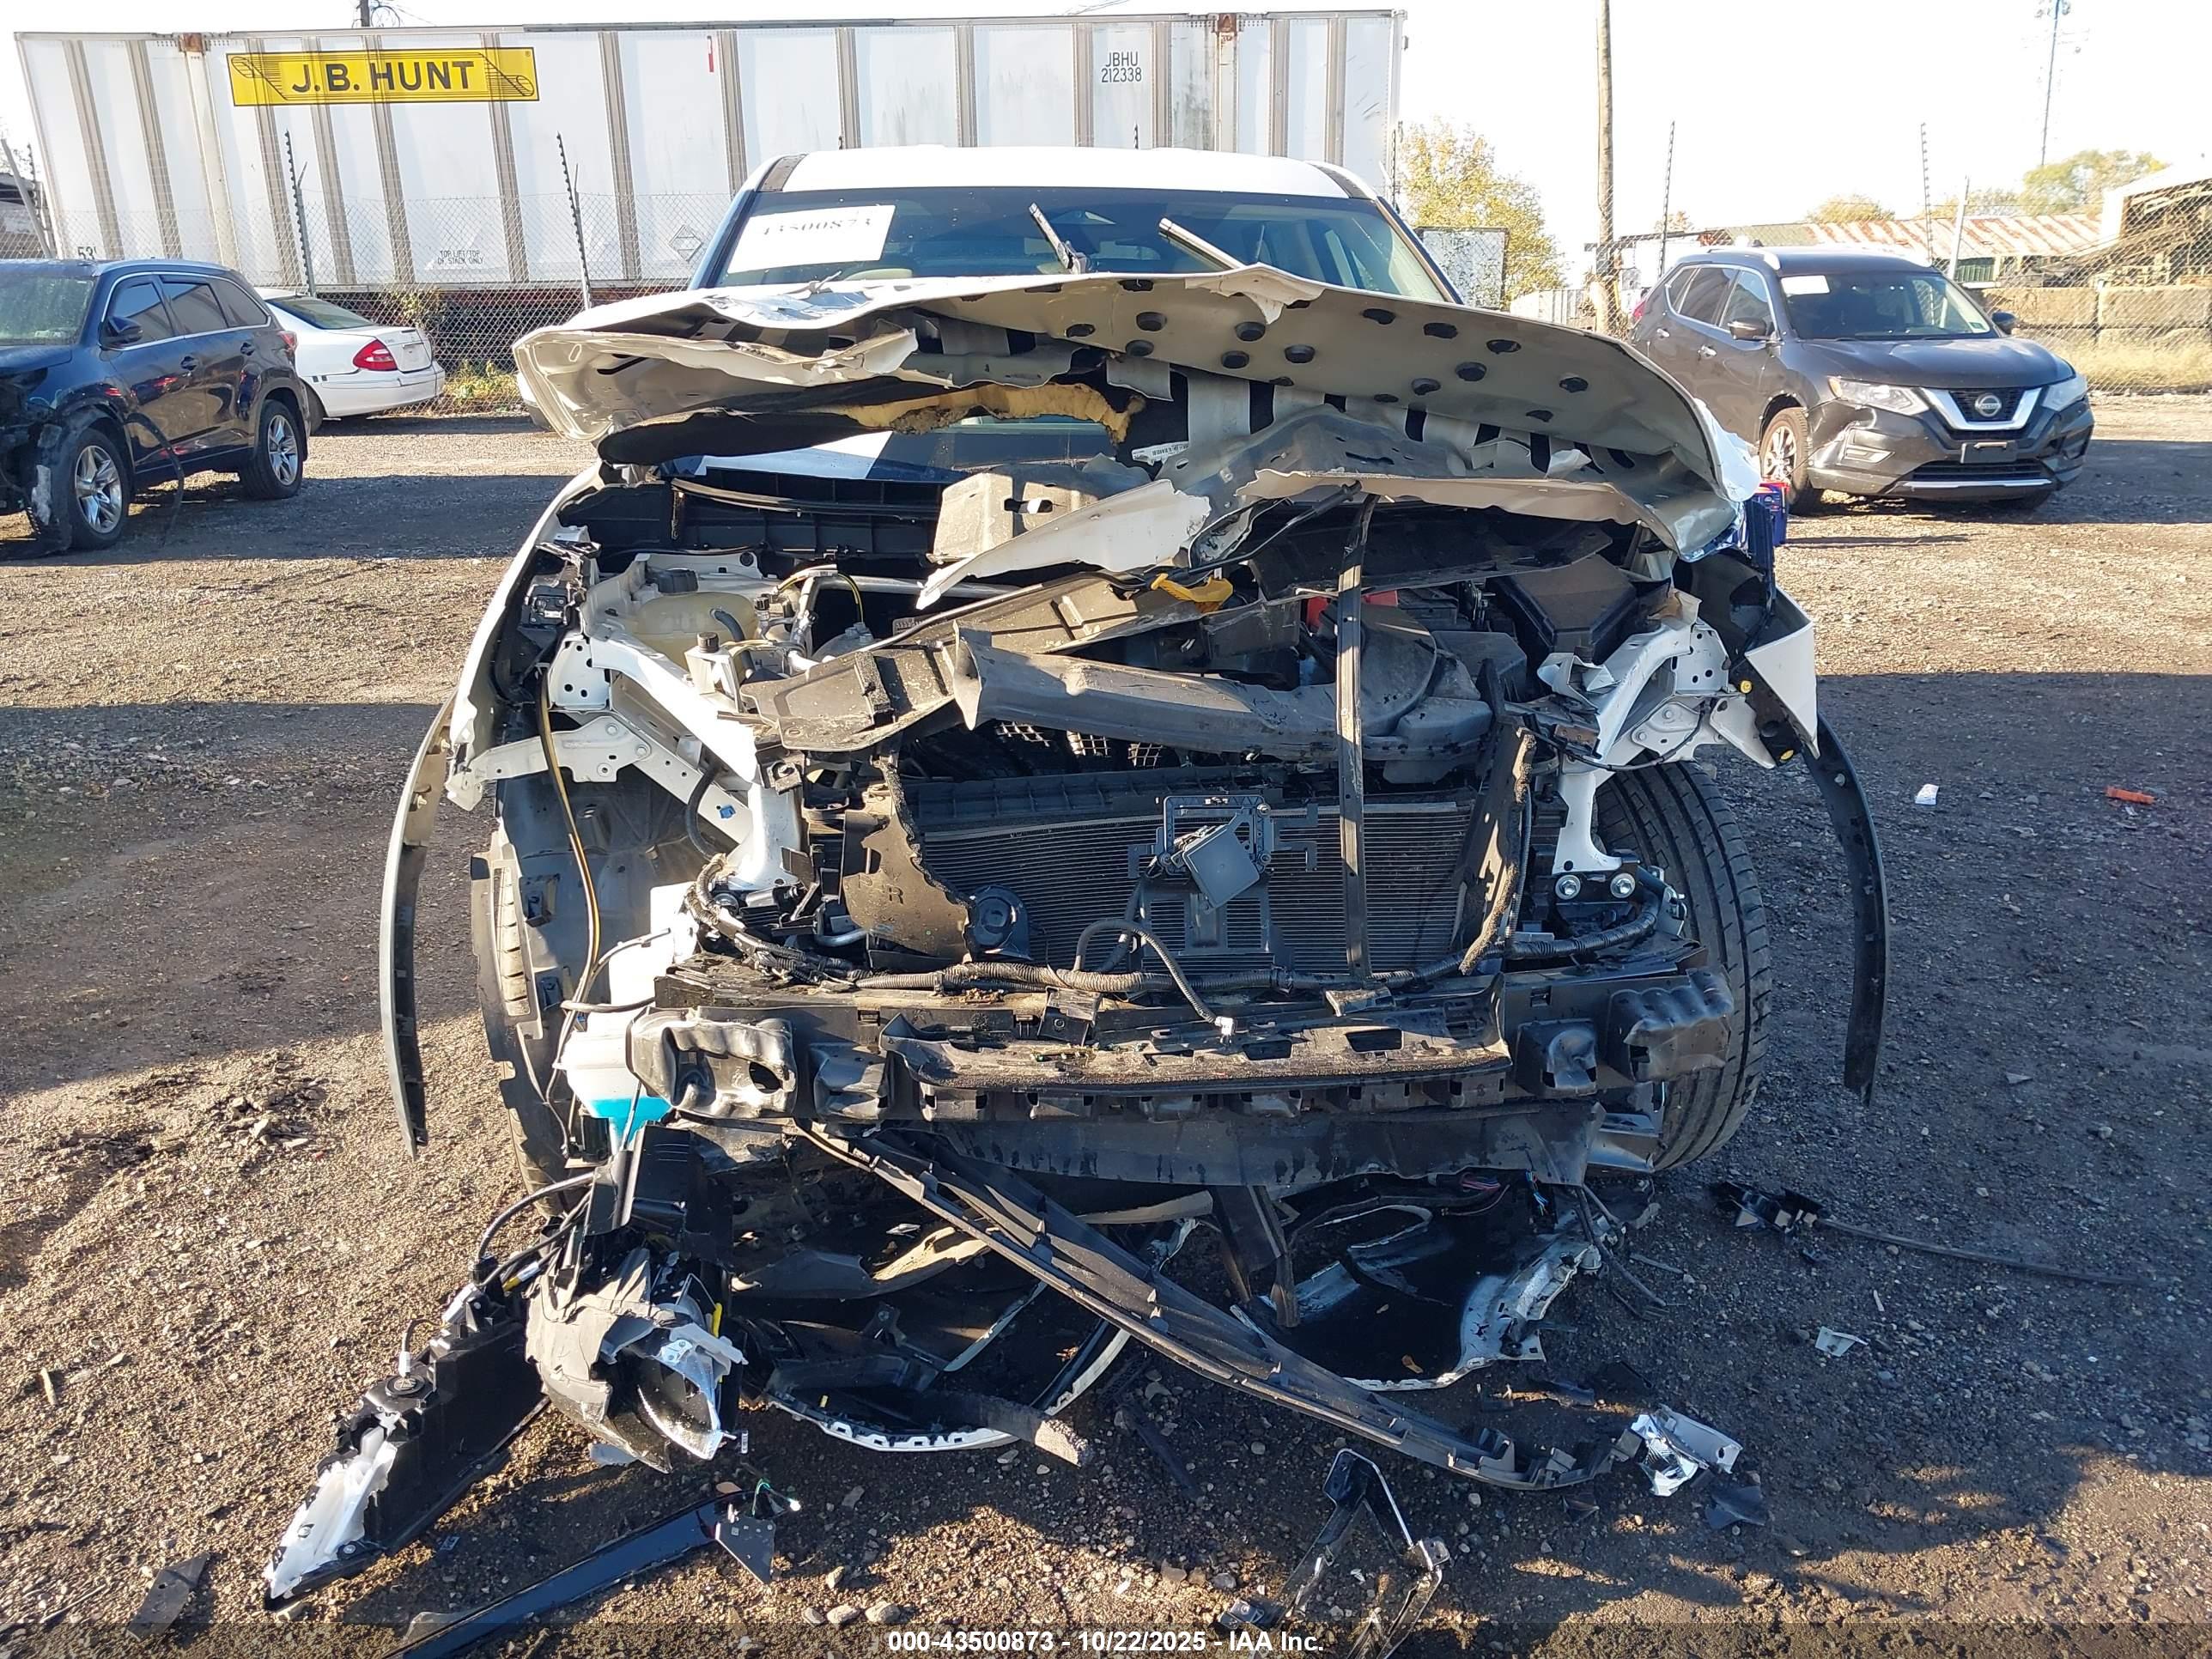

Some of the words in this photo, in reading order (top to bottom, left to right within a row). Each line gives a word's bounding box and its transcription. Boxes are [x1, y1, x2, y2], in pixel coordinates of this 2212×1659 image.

[1105, 51, 1139, 68] JBHU
[369, 60, 475, 91] HUNT
[1101, 66, 1142, 83] 212338
